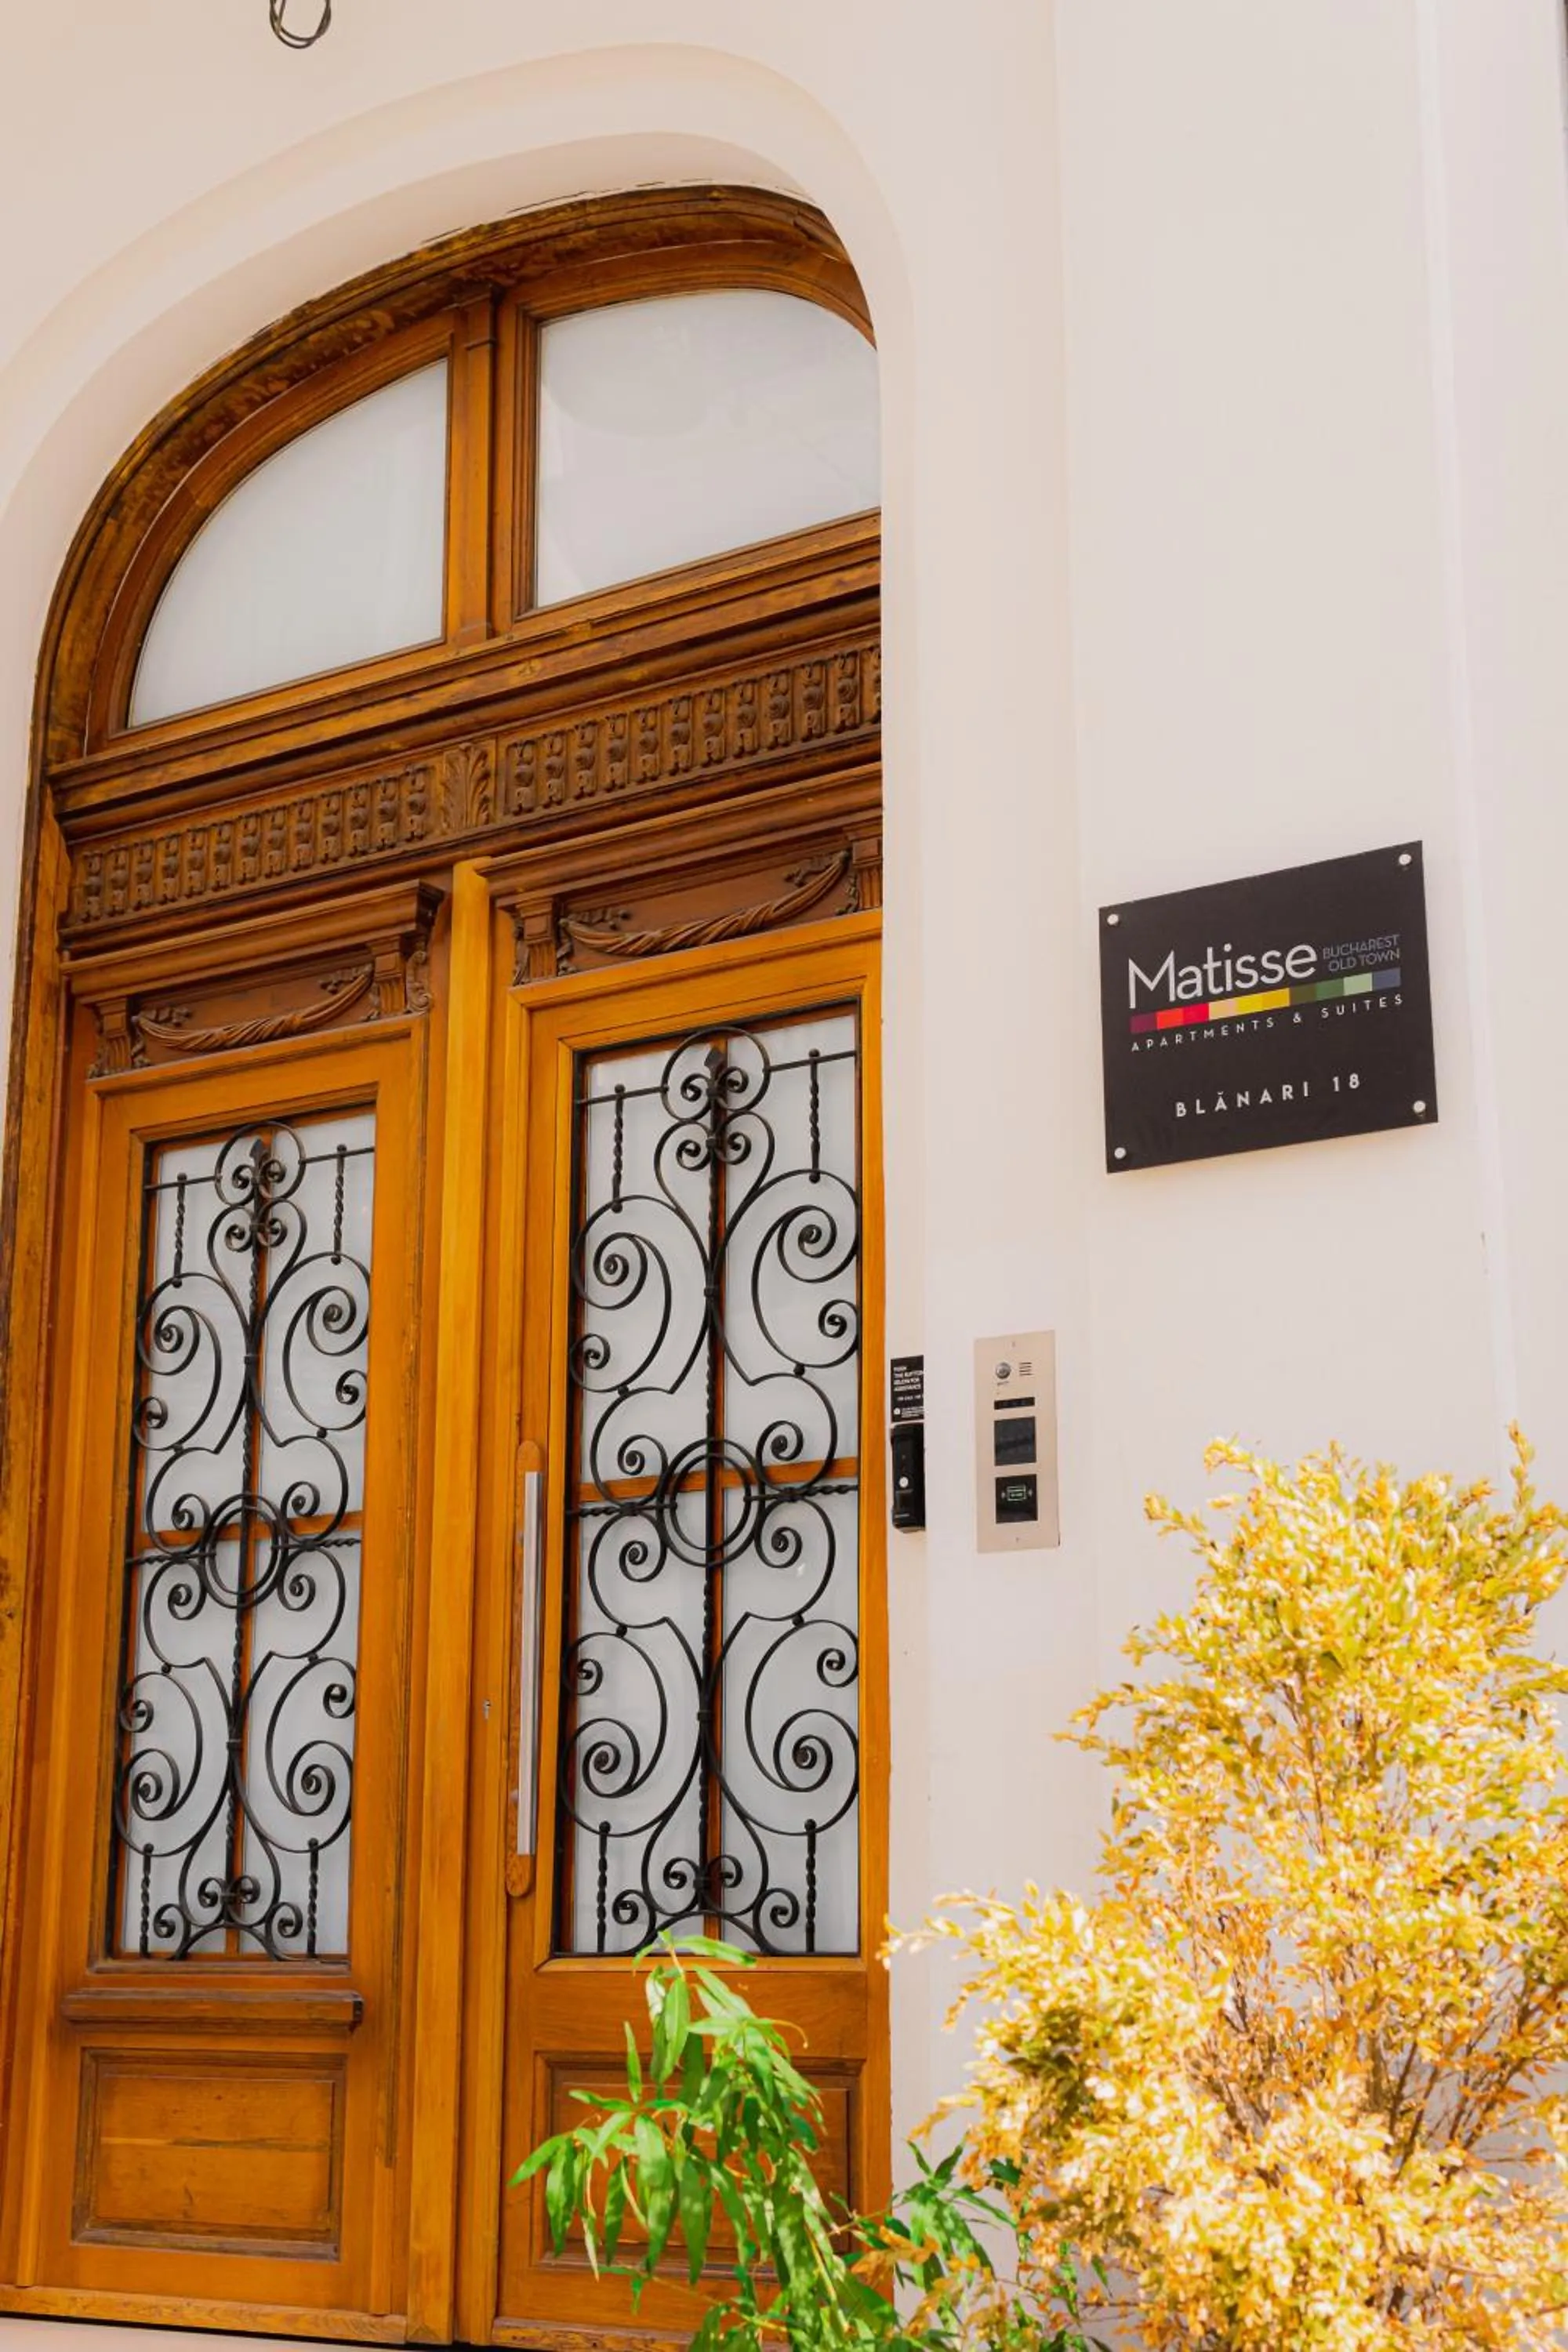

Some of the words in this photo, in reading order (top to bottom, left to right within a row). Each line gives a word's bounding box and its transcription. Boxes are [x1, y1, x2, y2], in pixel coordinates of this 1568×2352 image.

[1323, 934, 1400, 960] BUCHAREST
[1328, 956, 1356, 972] OLD
[1360, 948, 1400, 967] TOWN
[1128, 943, 1318, 1009] Matisse
[1131, 1017, 1274, 1052] APARTMENTS
[1293, 1011, 1301, 1023] &
[1320, 993, 1403, 1018] SUITES
[1175, 1080, 1309, 1117] BLĂNARI
[1333, 1073, 1360, 1092] 18
